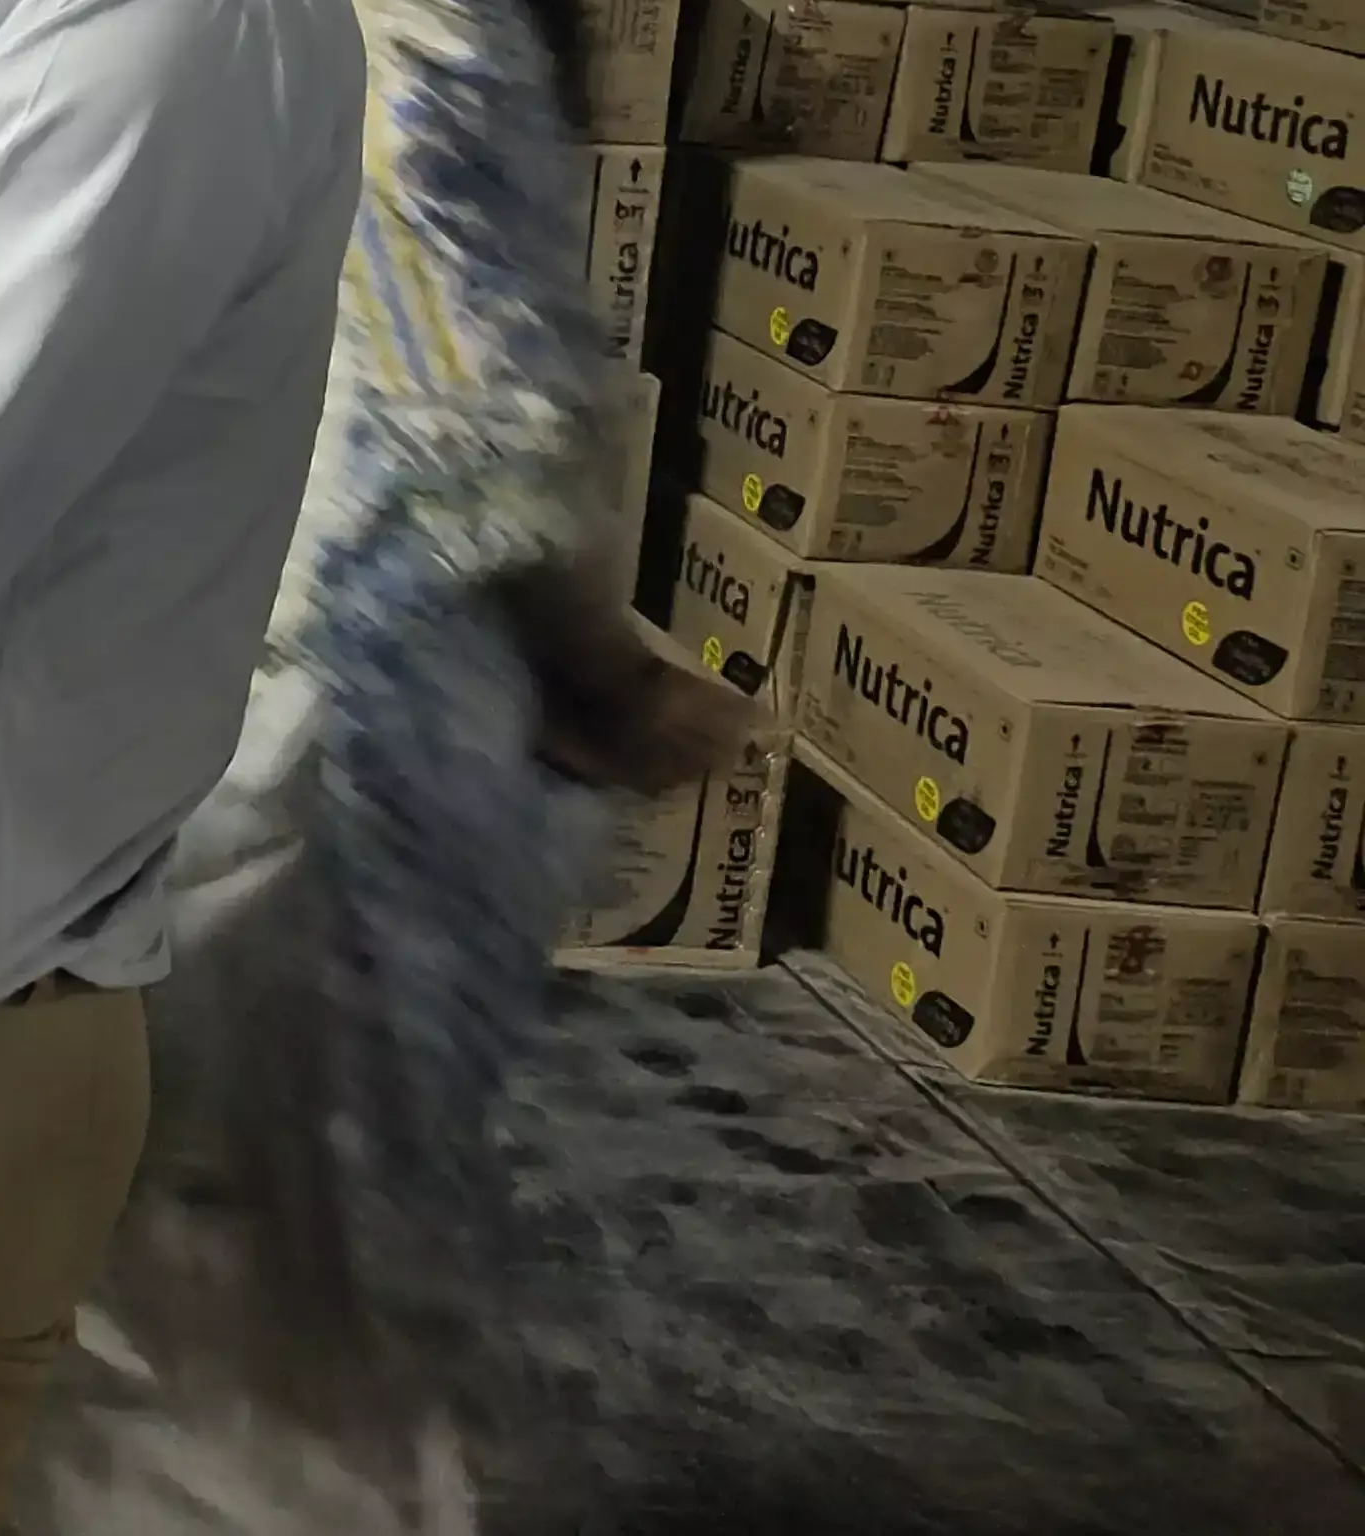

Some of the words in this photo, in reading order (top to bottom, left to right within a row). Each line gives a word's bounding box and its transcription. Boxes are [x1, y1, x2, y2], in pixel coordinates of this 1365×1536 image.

[929, 58, 957, 134] Nutrica
[1190, 73, 1349, 159] Nutrica
[727, 220, 819, 292] utrica
[1004, 313, 1039, 400] Nutrica
[1236, 324, 1275, 411] Nutrica
[701, 381, 788, 459] utrica
[970, 480, 1006, 565] Nutrica
[1086, 468, 1256, 601] Nutrica
[677, 542, 749, 626] trica
[834, 624, 969, 765] Nutrica
[1046, 766, 1083, 858] Nutrica
[1311, 787, 1348, 880] Nutrica
[705, 828, 755, 951] Nutrica
[836, 835, 945, 958] utrica
[1026, 964, 1061, 1056] Nutrica
